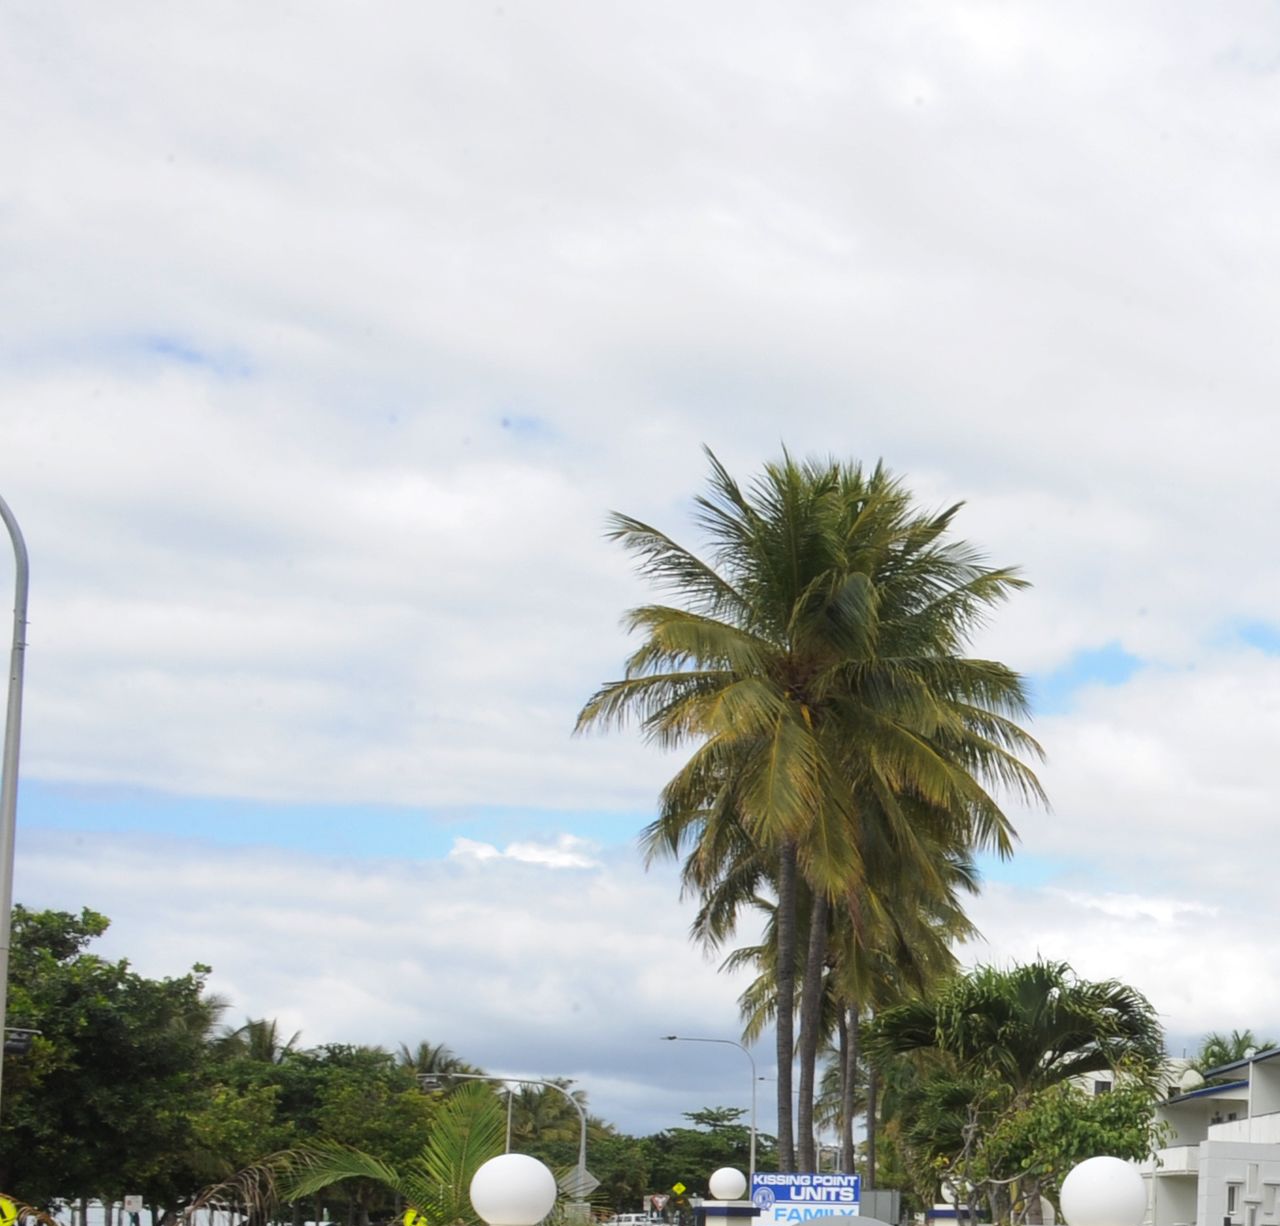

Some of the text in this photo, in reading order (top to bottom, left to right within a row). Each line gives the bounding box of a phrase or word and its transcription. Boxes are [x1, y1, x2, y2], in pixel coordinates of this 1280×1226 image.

[753, 1174, 858, 1187] KISSING POINT
[790, 1186, 855, 1201] UNITS
